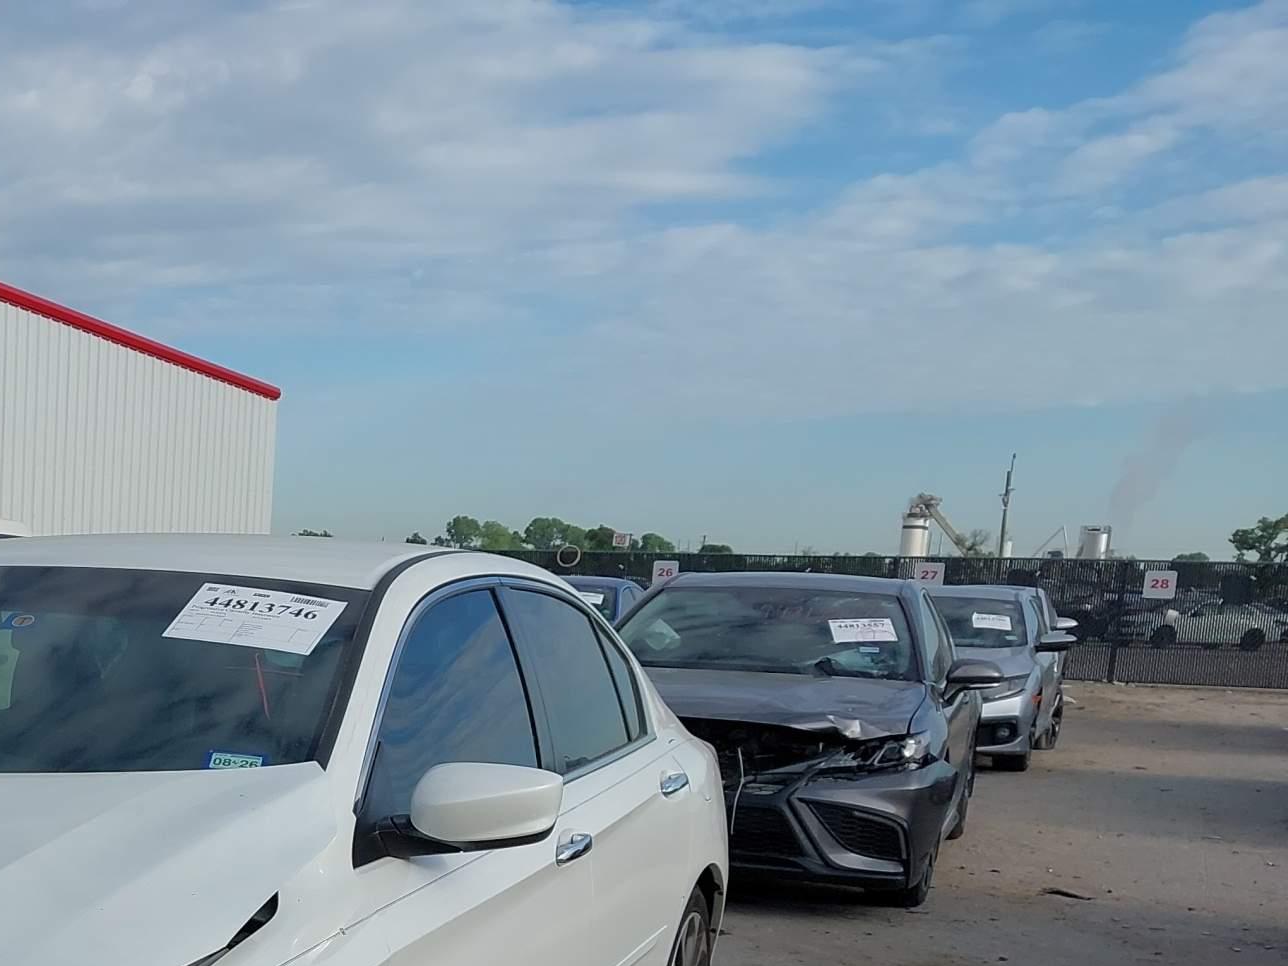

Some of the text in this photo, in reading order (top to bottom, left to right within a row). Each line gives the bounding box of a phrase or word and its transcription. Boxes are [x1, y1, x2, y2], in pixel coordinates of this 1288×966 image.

[657, 568, 673, 577] 26
[920, 570, 938, 580] 27
[1151, 578, 1170, 590] 28
[204, 597, 318, 621] 44813746
